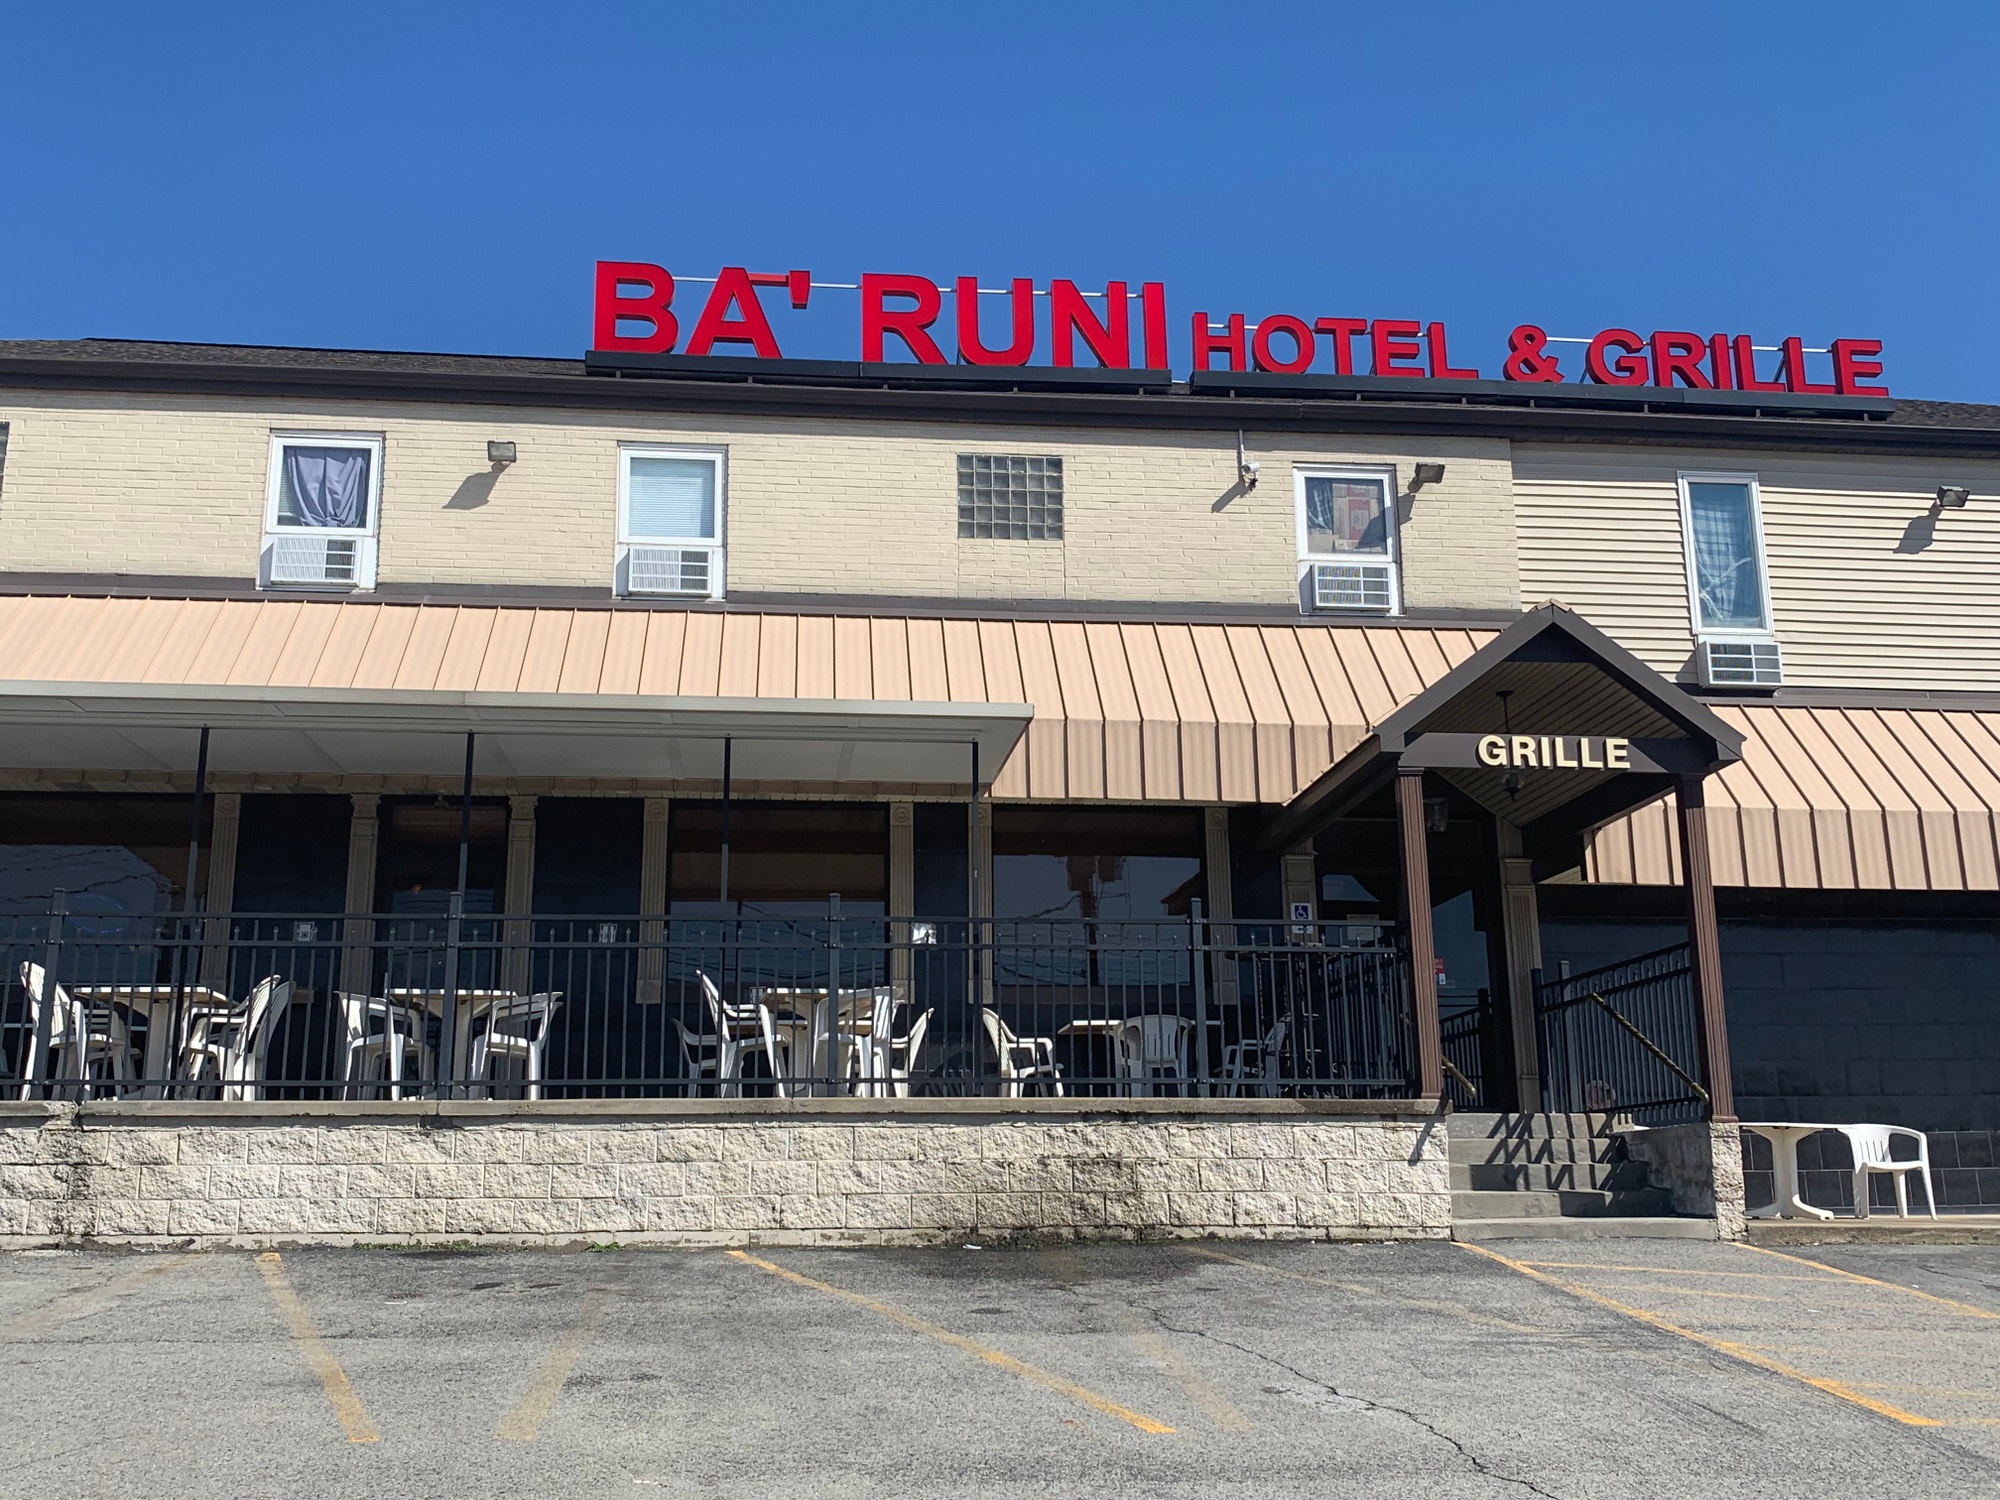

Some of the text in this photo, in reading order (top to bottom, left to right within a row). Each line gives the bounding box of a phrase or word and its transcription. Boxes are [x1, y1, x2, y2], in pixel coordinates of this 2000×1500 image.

[860, 272, 1168, 371] RUNI
[1192, 311, 1479, 381] HOTEL
[1504, 324, 1565, 384] &
[1587, 328, 1889, 398] GRILLE
[1478, 734, 1631, 769] GRILLE
